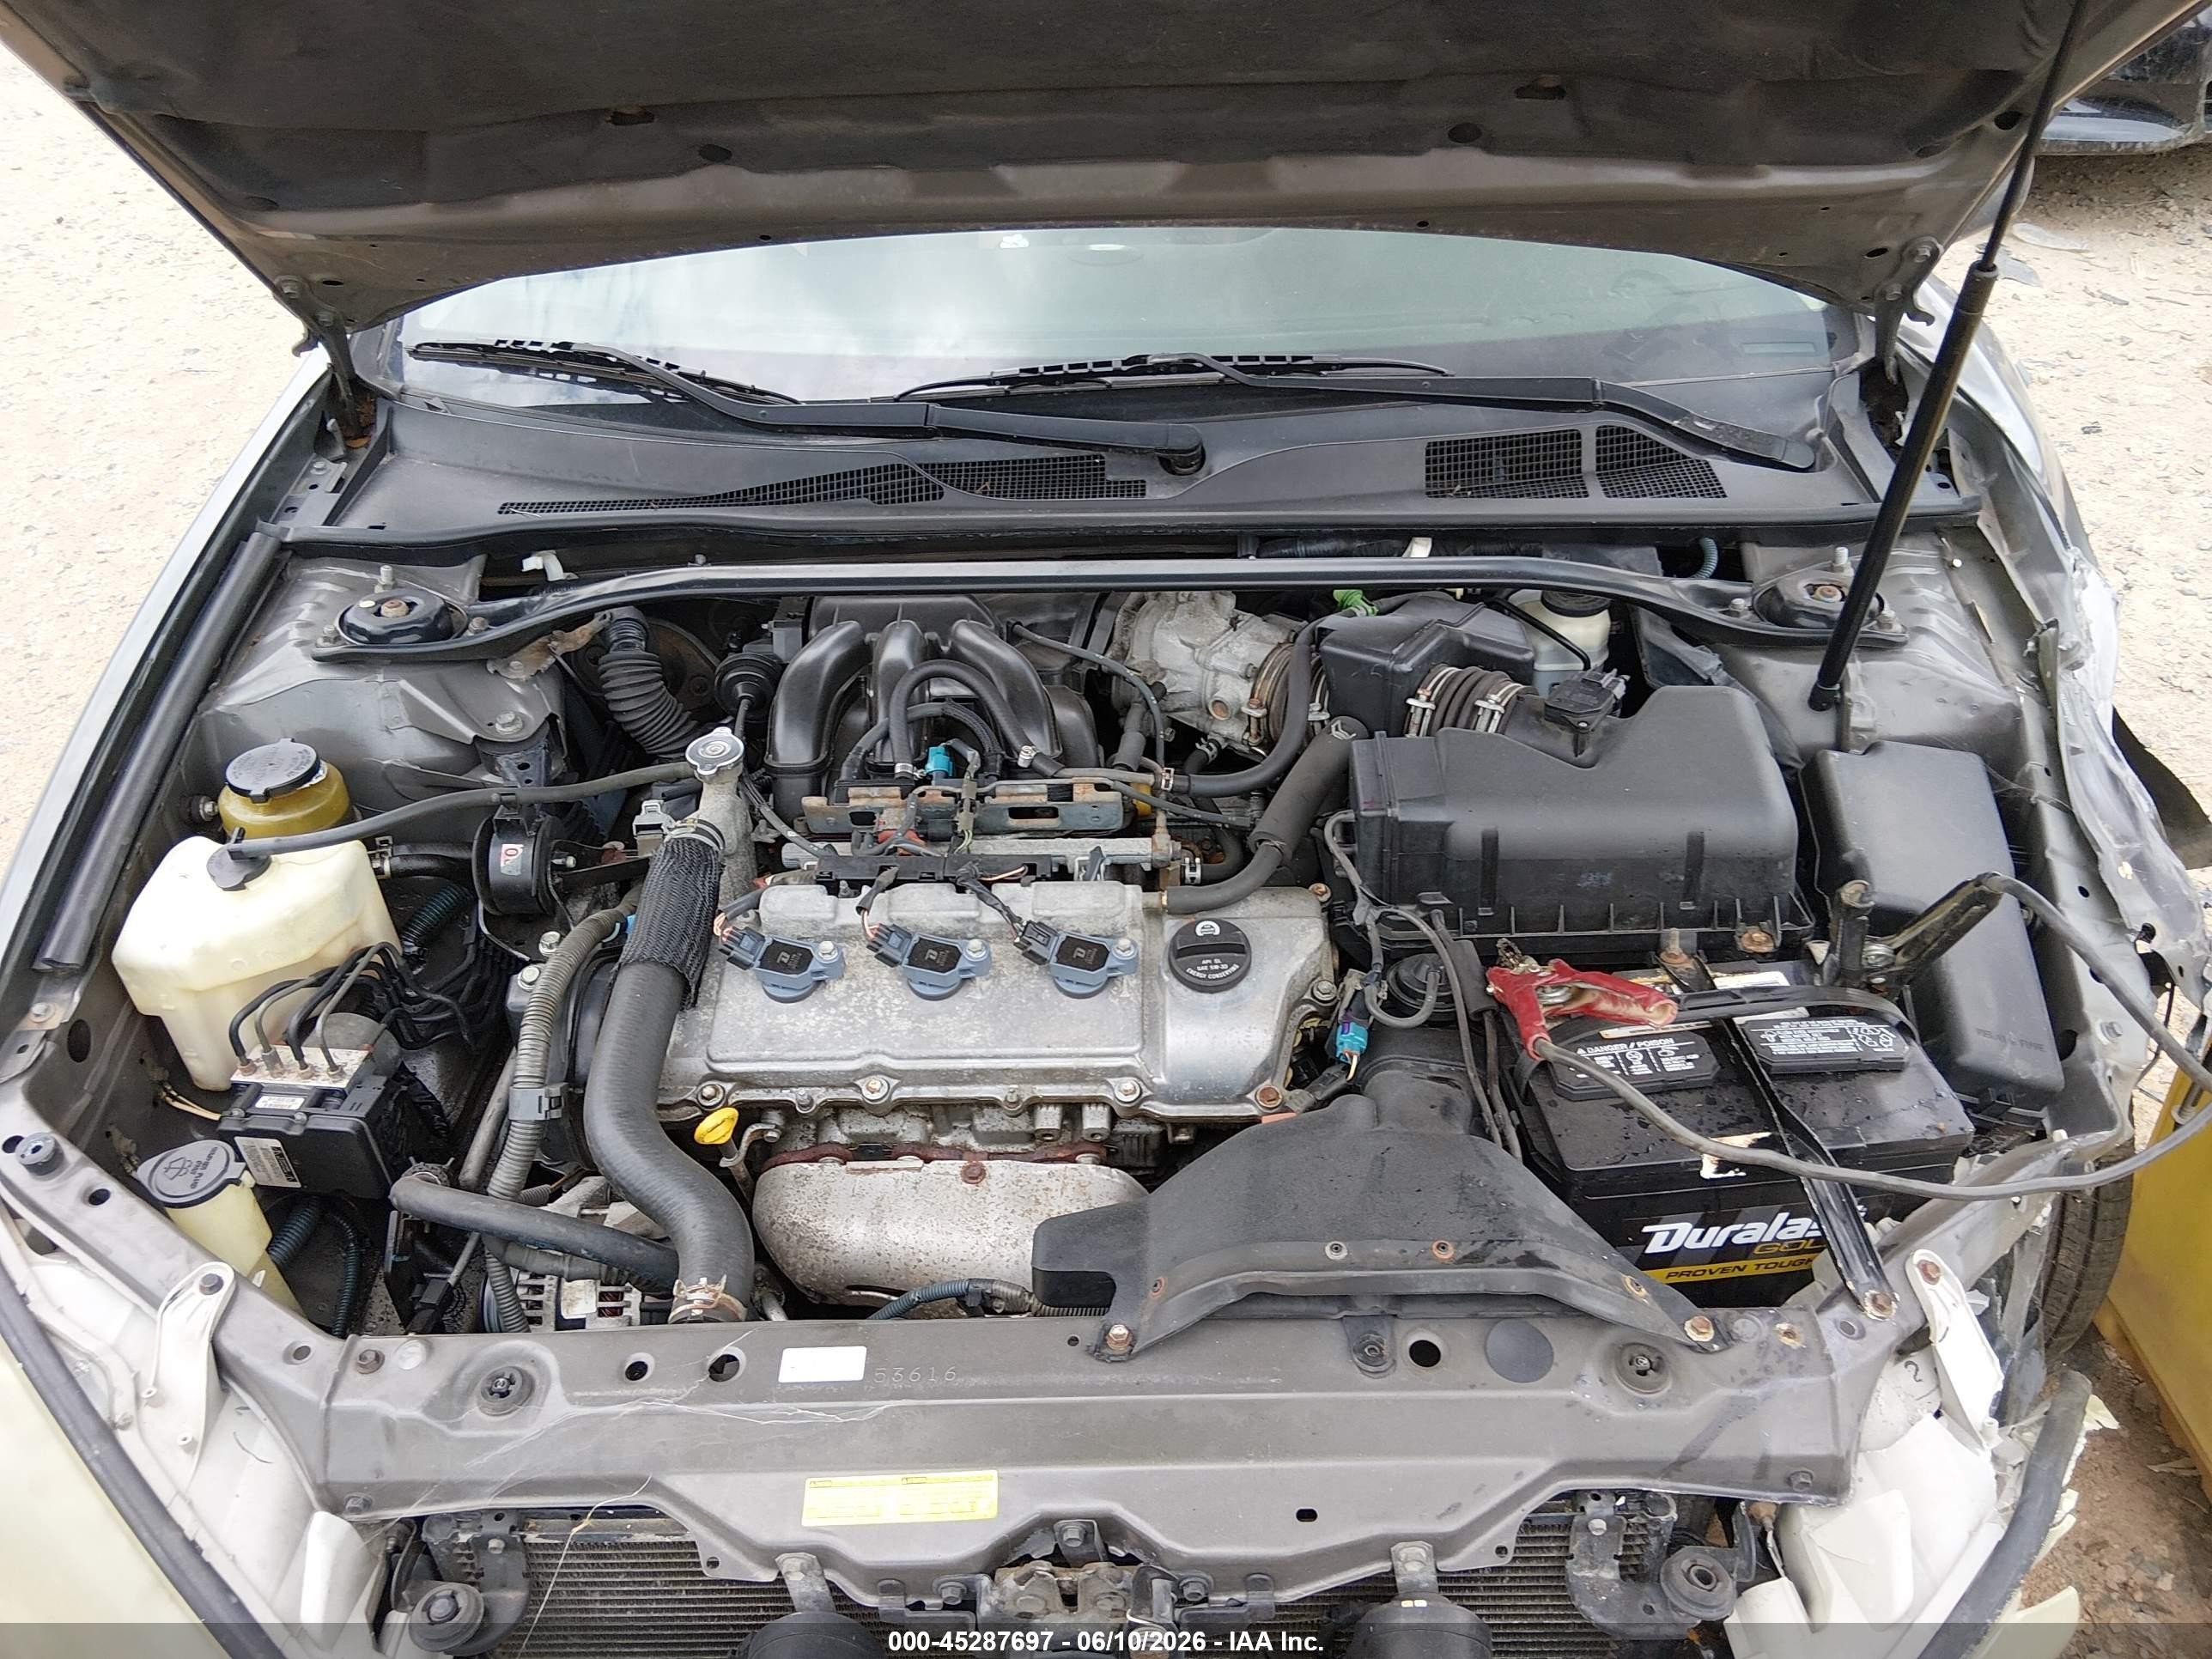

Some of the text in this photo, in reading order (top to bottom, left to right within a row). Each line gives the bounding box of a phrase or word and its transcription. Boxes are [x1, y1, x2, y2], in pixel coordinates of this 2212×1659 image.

[1586, 1042, 1628, 1054] DANGER
[1637, 1038, 1675, 1048] POISON
[1753, 1239, 1827, 1255] GOL
[1665, 1264, 1747, 1279] PROVEN
[874, 1366, 957, 1383] 53616
